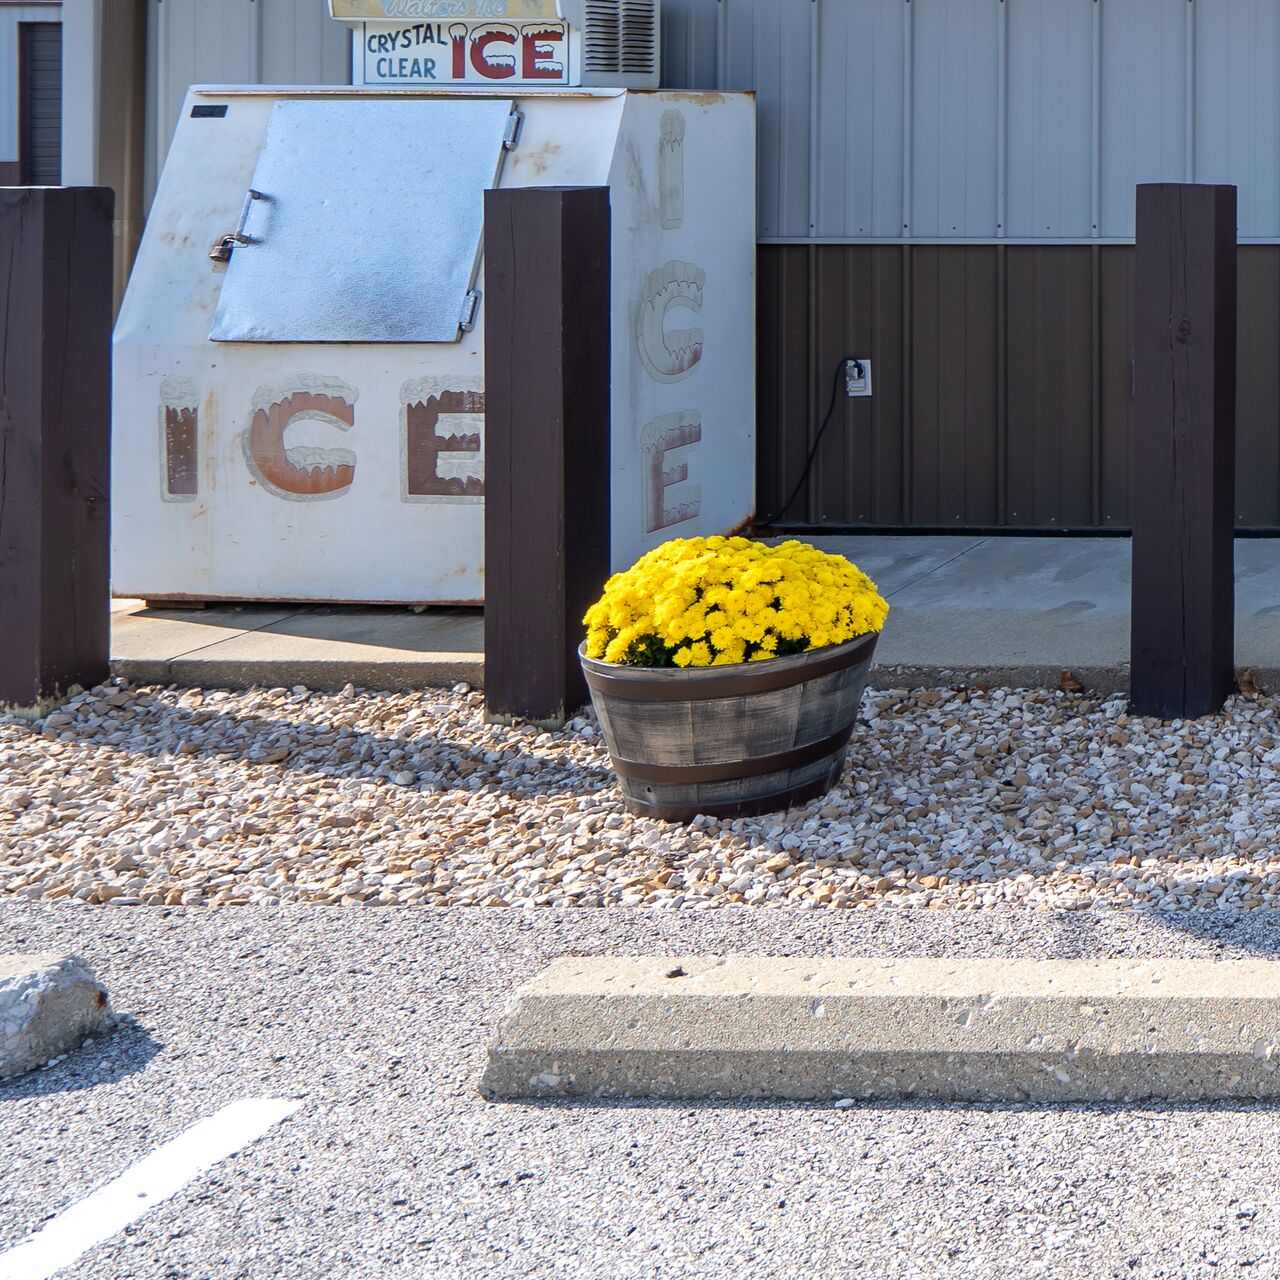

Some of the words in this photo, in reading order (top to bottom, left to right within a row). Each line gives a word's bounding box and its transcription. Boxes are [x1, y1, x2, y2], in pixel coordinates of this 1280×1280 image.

[367, 23, 449, 55] CRYSTAL
[448, 22, 565, 79] ICE
[377, 57, 437, 80] CLEAR
[158, 372, 485, 504] ICE
